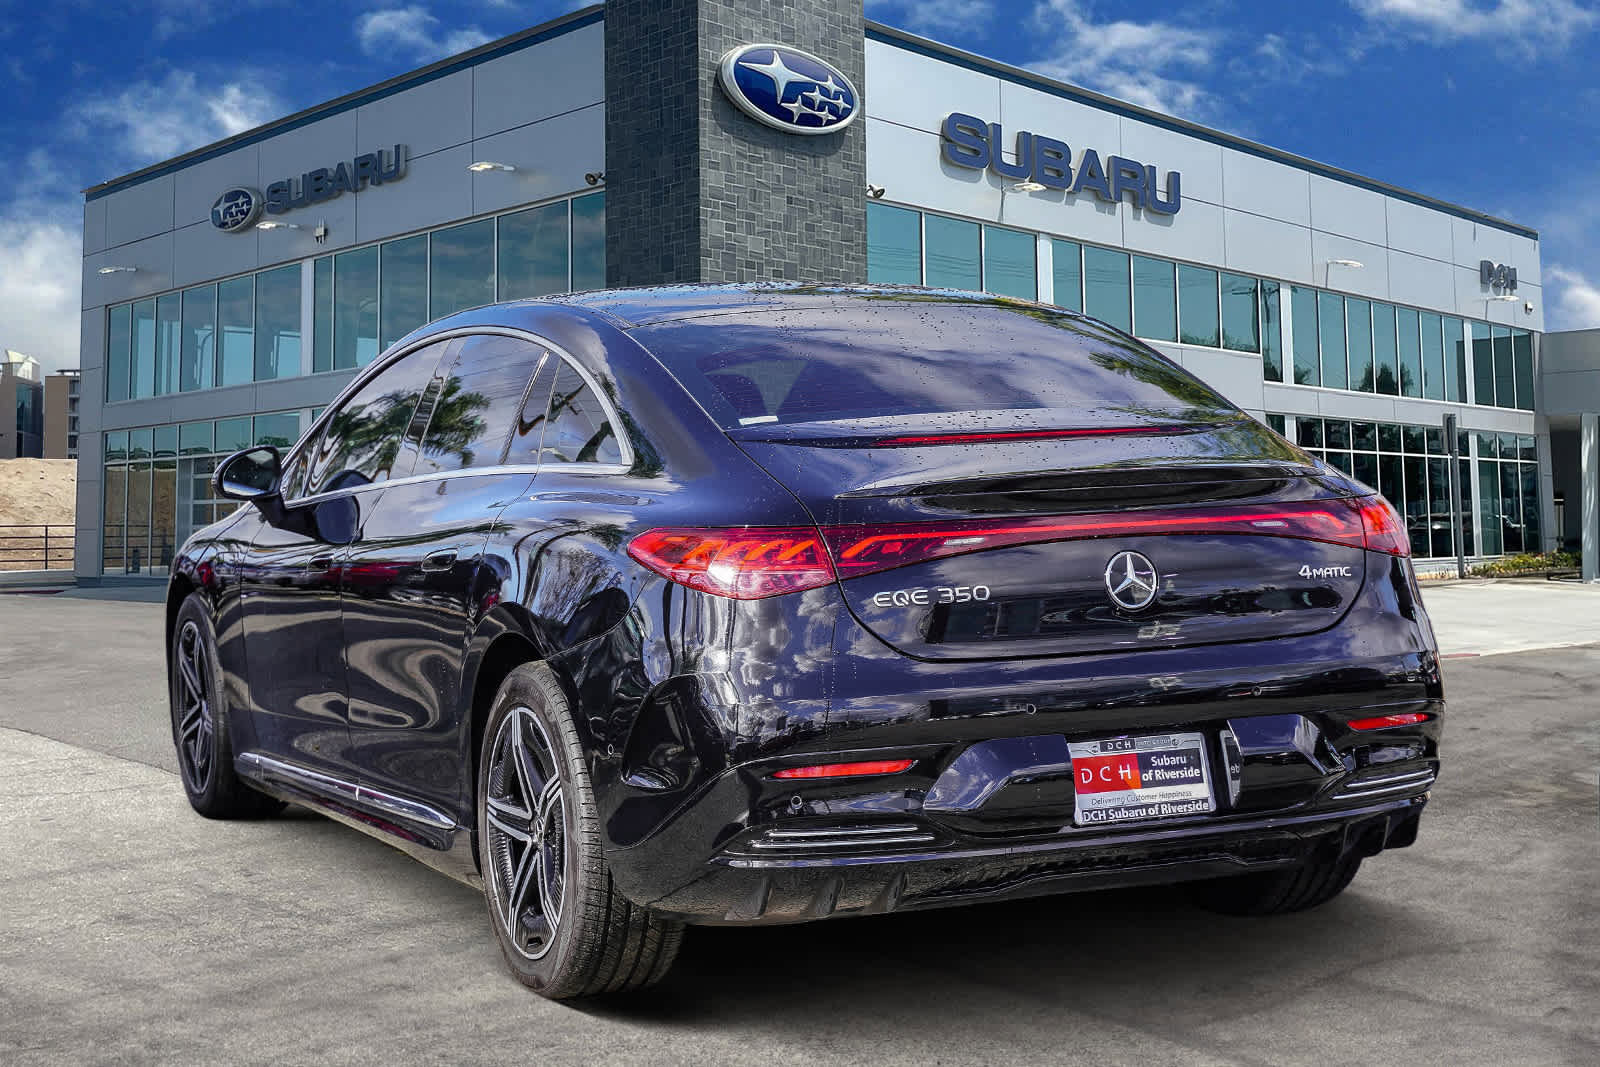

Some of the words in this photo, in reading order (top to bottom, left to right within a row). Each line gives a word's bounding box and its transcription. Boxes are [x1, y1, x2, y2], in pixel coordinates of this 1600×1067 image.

[941, 112, 1181, 215] SUBARU
[266, 144, 407, 214] SUBARU
[1480, 260, 1518, 290] DCH
[1298, 564, 1353, 580] 4MATIC
[873, 589, 929, 608] EQE
[937, 585, 991, 604] 350
[1106, 741, 1132, 751] DCH
[1151, 755, 1187, 767] Subaru
[1080, 764, 1132, 784] DCH
[1142, 771, 1153, 782] of
[1154, 767, 1201, 780] Riverside
[1091, 796, 1125, 806] Delivering
[1126, 793, 1158, 803] Customer
[1159, 790, 1193, 801] Happiness
[1082, 809, 1107, 822] DCH
[1108, 805, 1147, 819] Subaru
[1148, 803, 1160, 815] of
[1160, 799, 1209, 815] Riverside
